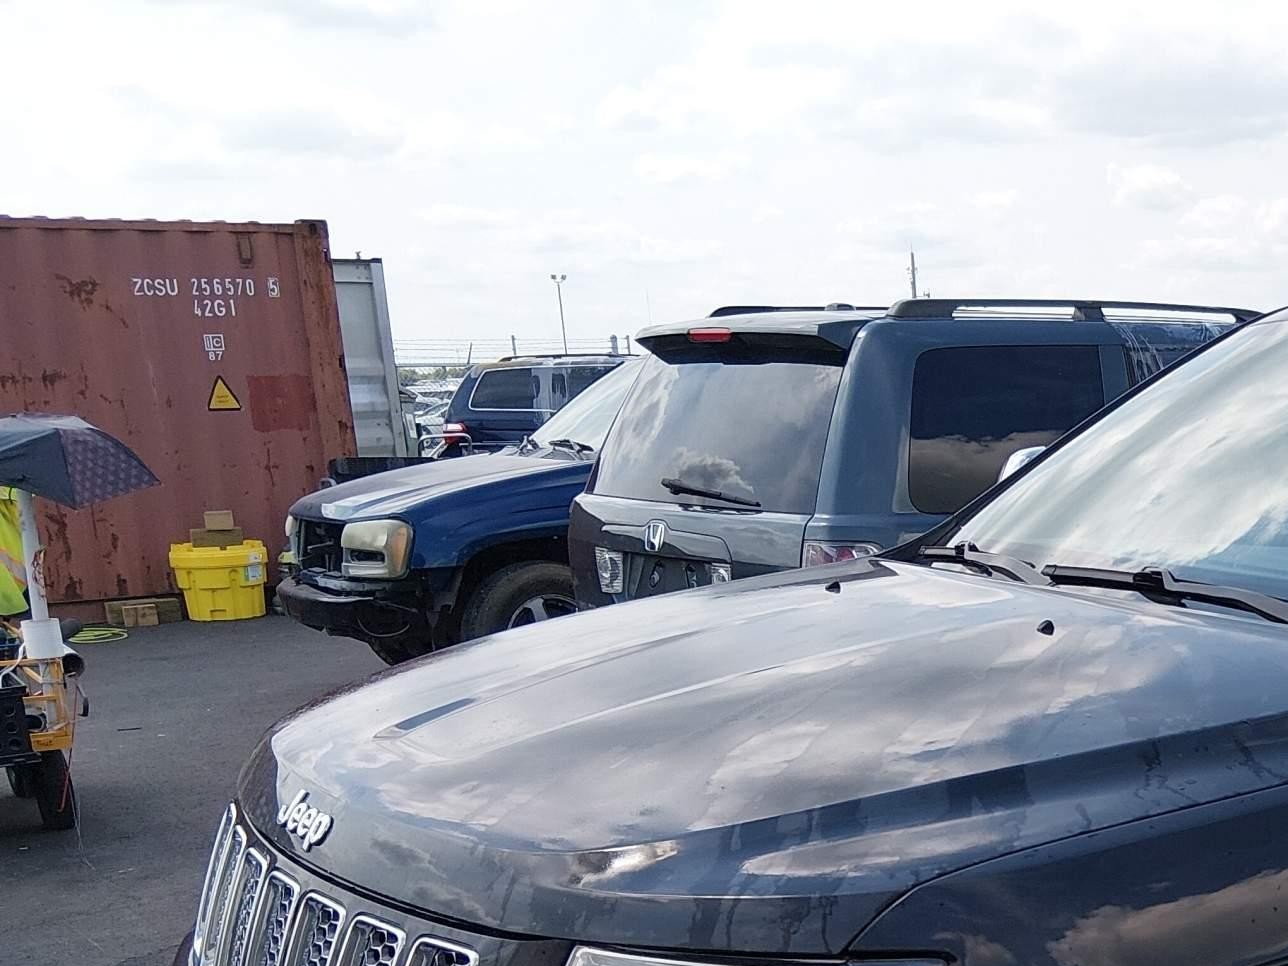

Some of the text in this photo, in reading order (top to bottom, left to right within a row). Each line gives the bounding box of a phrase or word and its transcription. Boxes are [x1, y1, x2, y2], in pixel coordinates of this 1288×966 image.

[132, 278, 178, 296] ZCSU
[191, 278, 254, 296] 256570
[194, 299, 236, 316] 42G1
[209, 351, 222, 361] 87
[276, 789, 333, 852] Jeep
